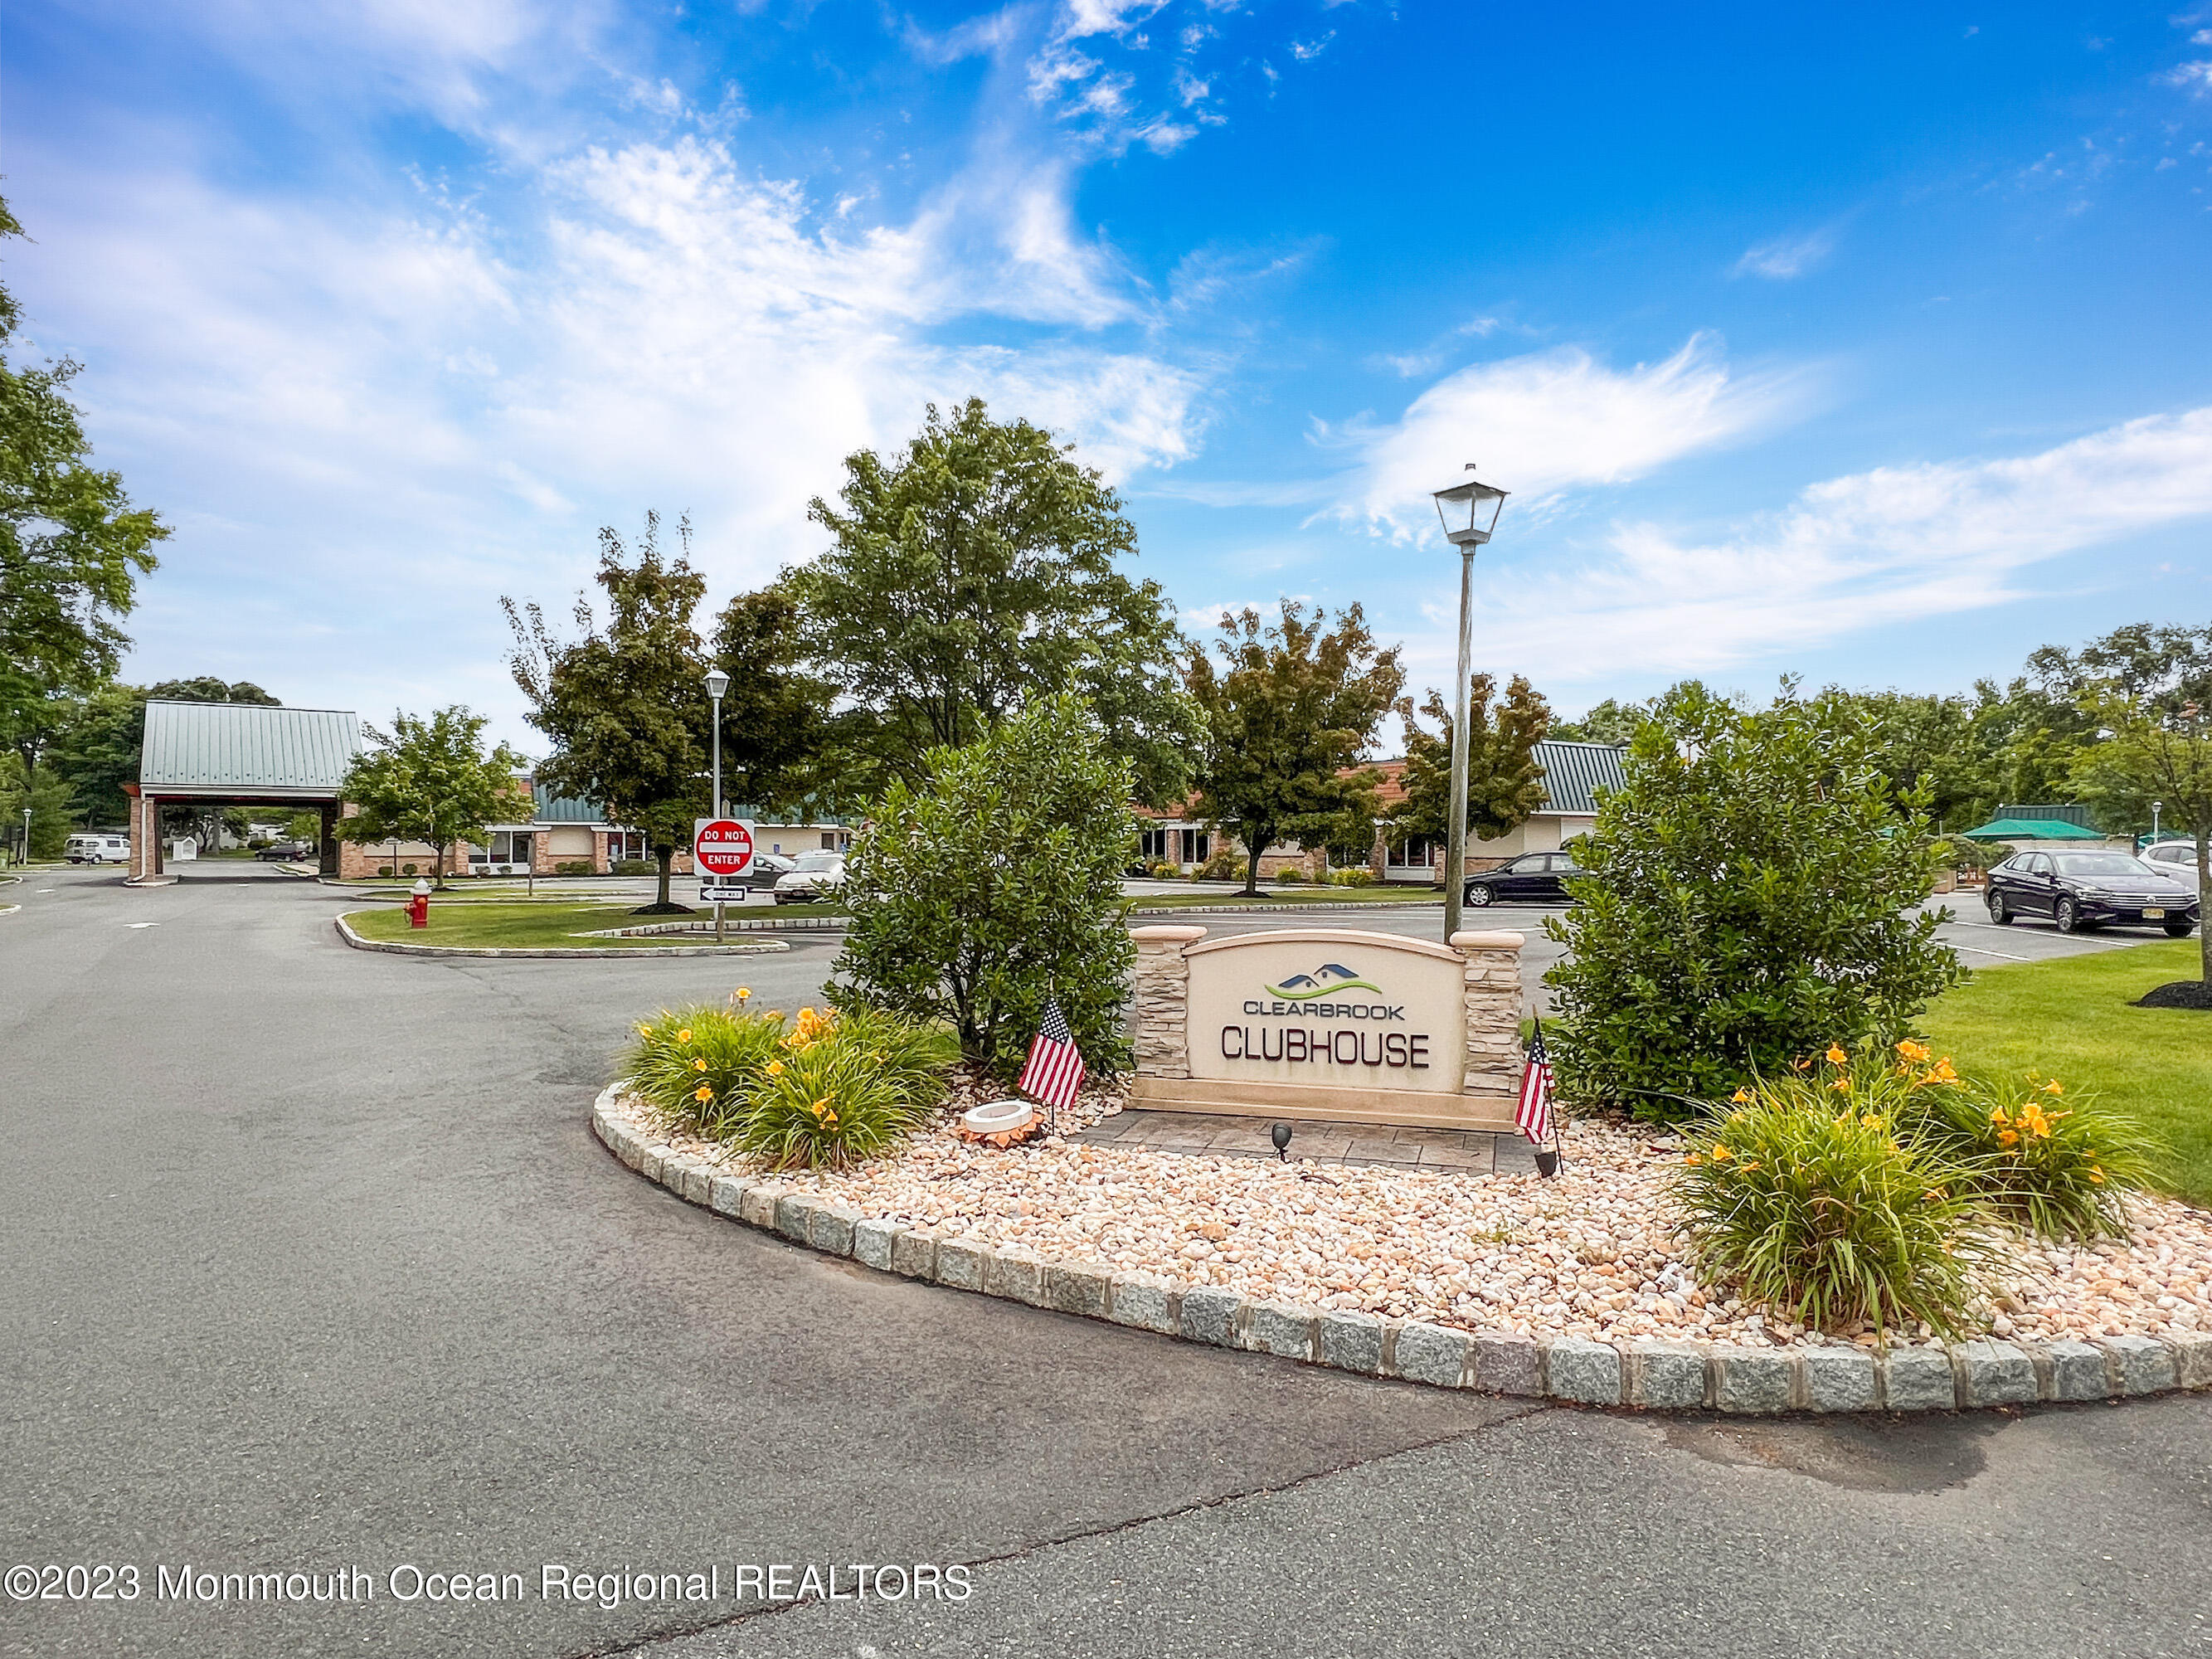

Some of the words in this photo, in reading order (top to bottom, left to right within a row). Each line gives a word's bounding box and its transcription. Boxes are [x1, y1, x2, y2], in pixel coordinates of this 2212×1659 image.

[704, 830, 719, 840] DO
[724, 830, 745, 840] NOT
[707, 855, 741, 864] ENTER
[1243, 1000, 1405, 1021] CLEARBROOK
[1221, 1024, 1430, 1069] CLUBHOUSE
